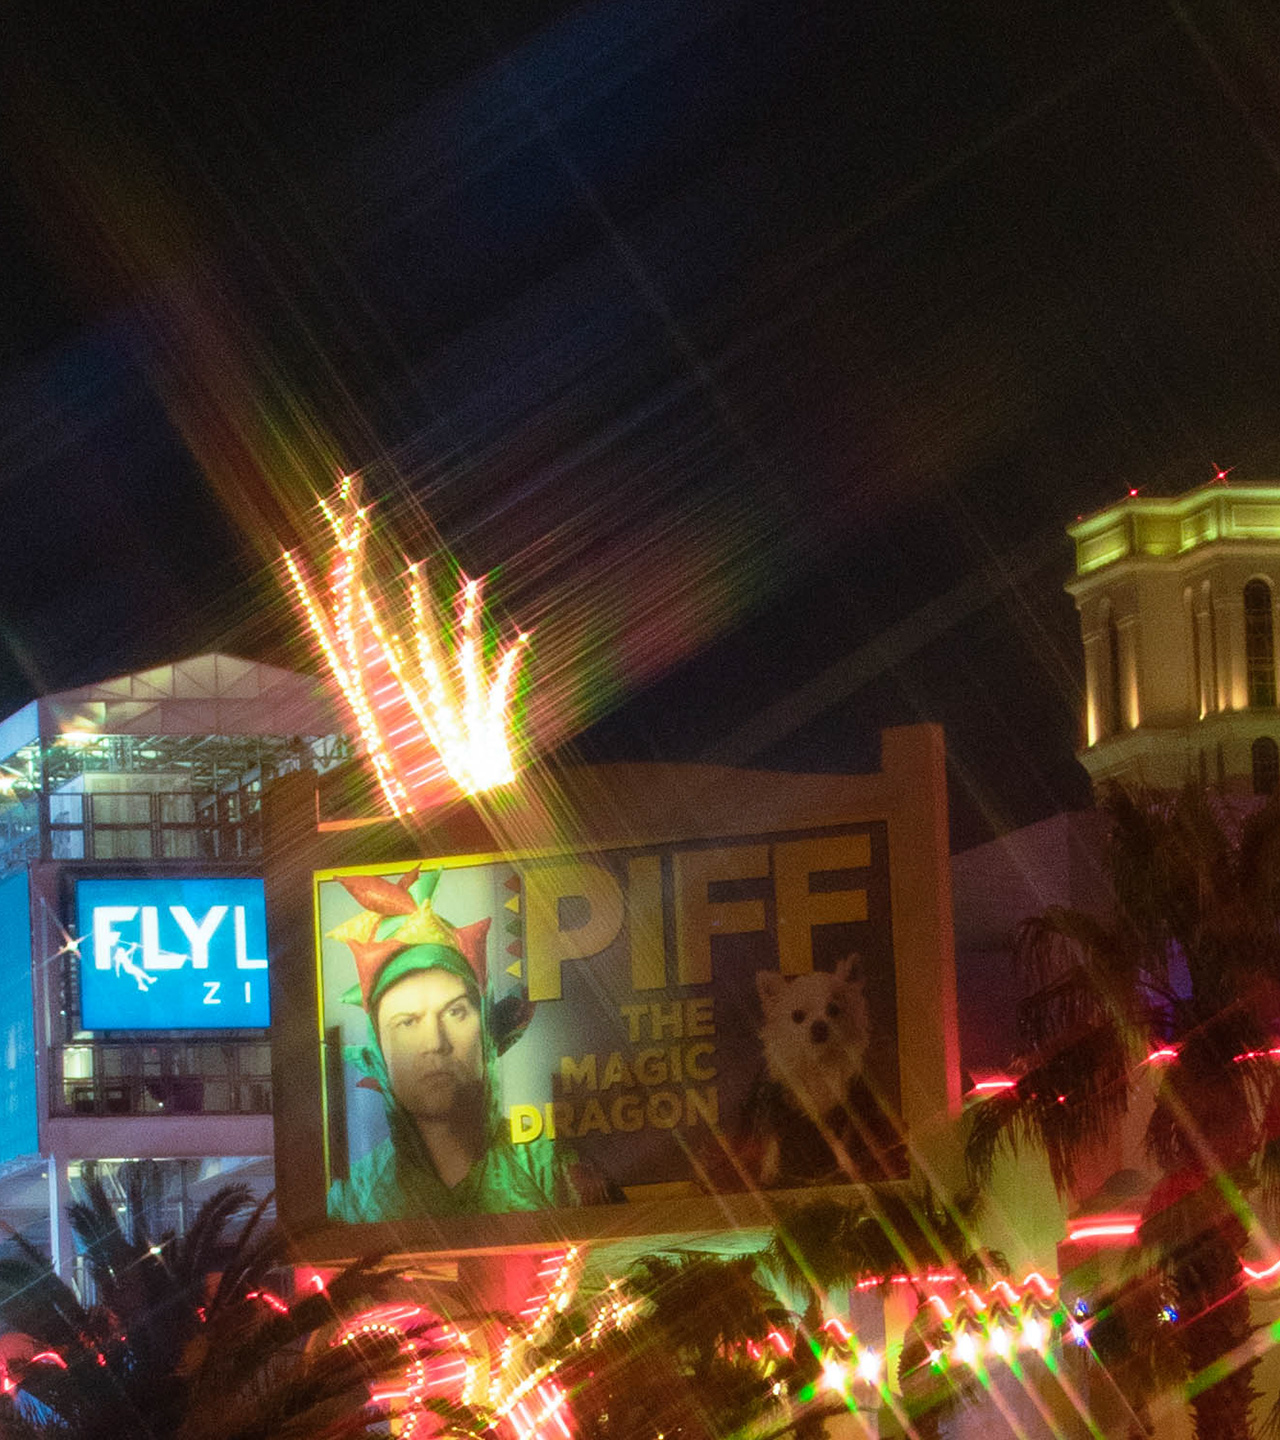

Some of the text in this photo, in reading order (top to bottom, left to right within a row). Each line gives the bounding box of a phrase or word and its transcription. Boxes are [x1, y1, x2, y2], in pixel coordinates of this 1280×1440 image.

[520, 831, 873, 1004] PIFF
[621, 995, 718, 1043] THE
[559, 1040, 719, 1093] MAGIC
[507, 1085, 721, 1145] DRAGON
